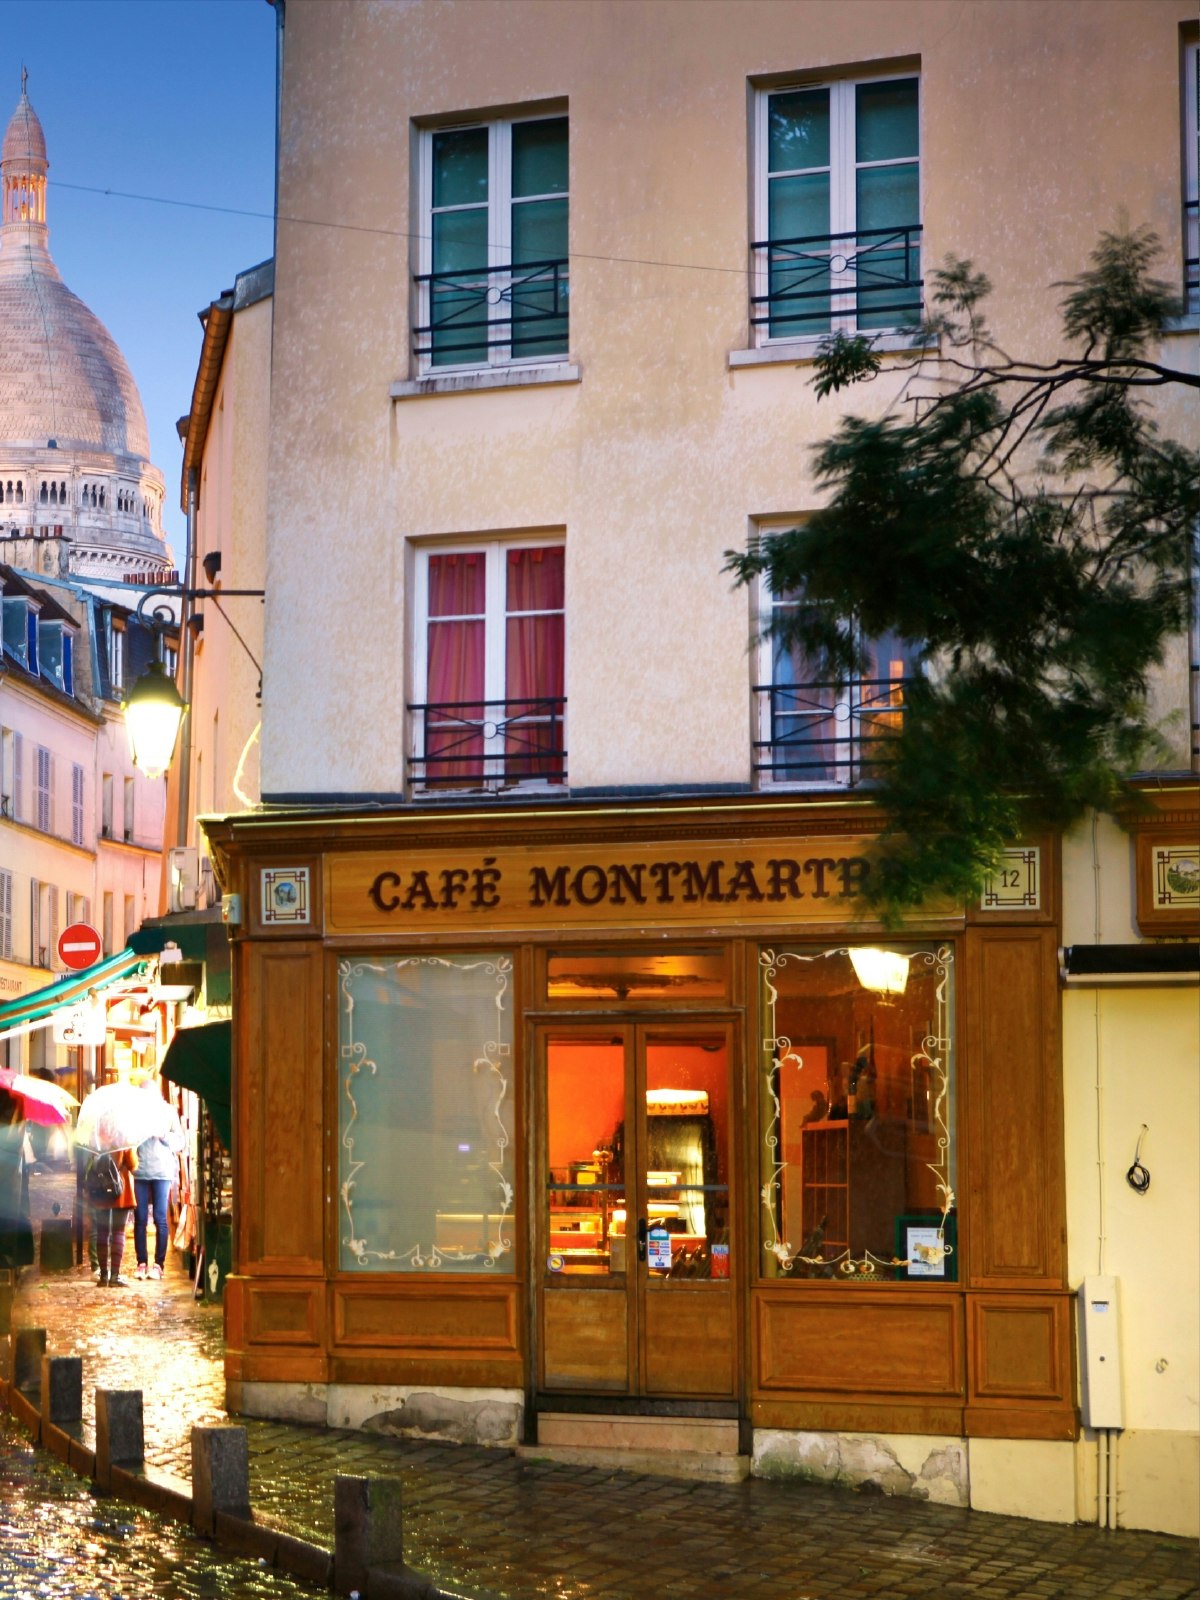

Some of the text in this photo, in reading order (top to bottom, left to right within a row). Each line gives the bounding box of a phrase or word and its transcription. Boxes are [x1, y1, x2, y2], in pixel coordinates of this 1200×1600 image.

[369, 857, 890, 911] CAFÉ MONTMARTR
[999, 869, 1020, 888] 12
